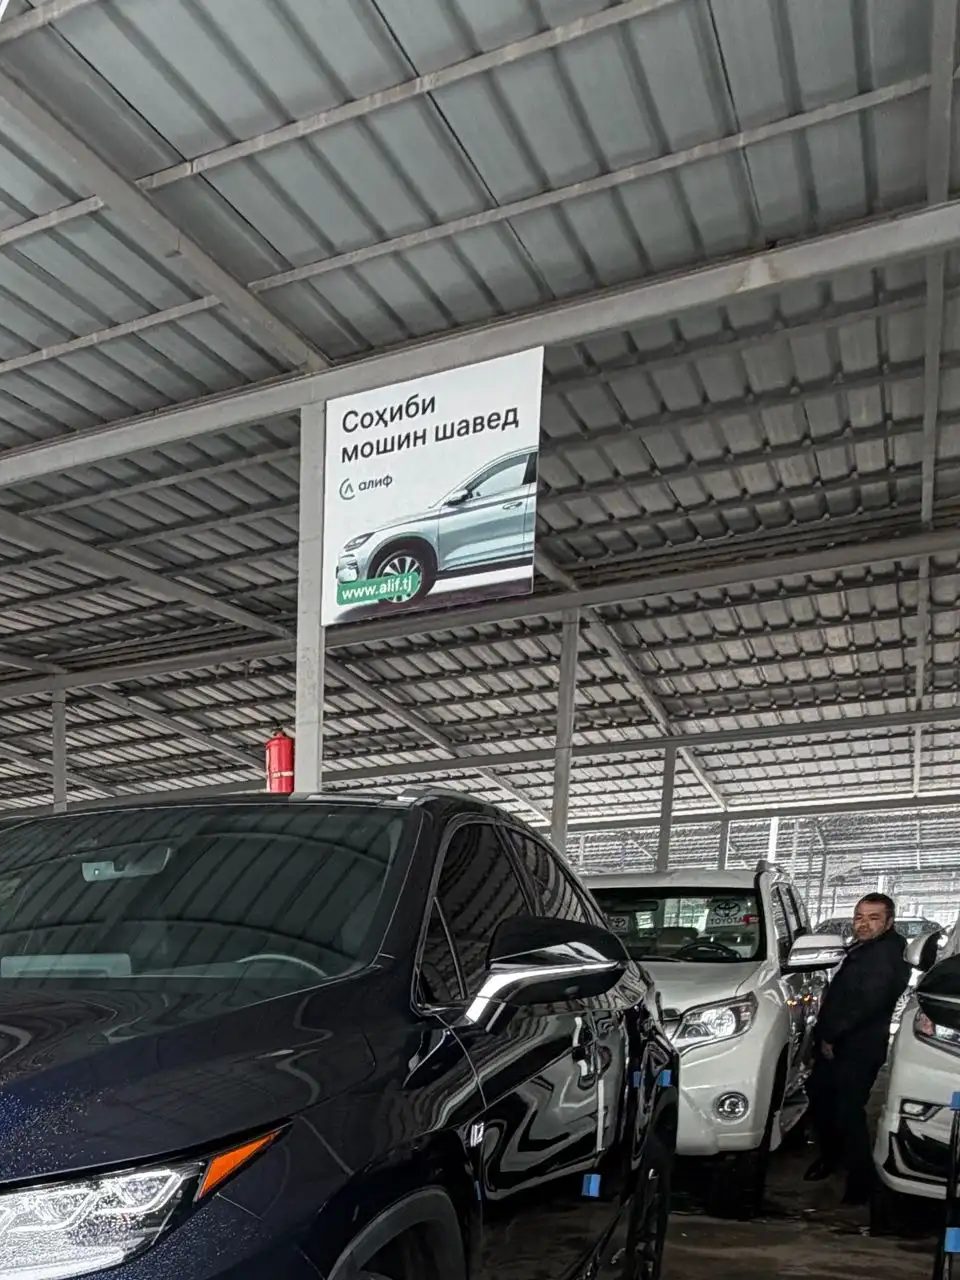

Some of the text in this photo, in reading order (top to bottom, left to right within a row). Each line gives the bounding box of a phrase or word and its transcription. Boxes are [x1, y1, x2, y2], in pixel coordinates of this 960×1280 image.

[342, 393, 436, 433] Соҳиби
[341, 407, 519, 463] мошин шавед
[358, 475, 393, 491] алиф
[341, 574, 412, 600] www.alif.tj
